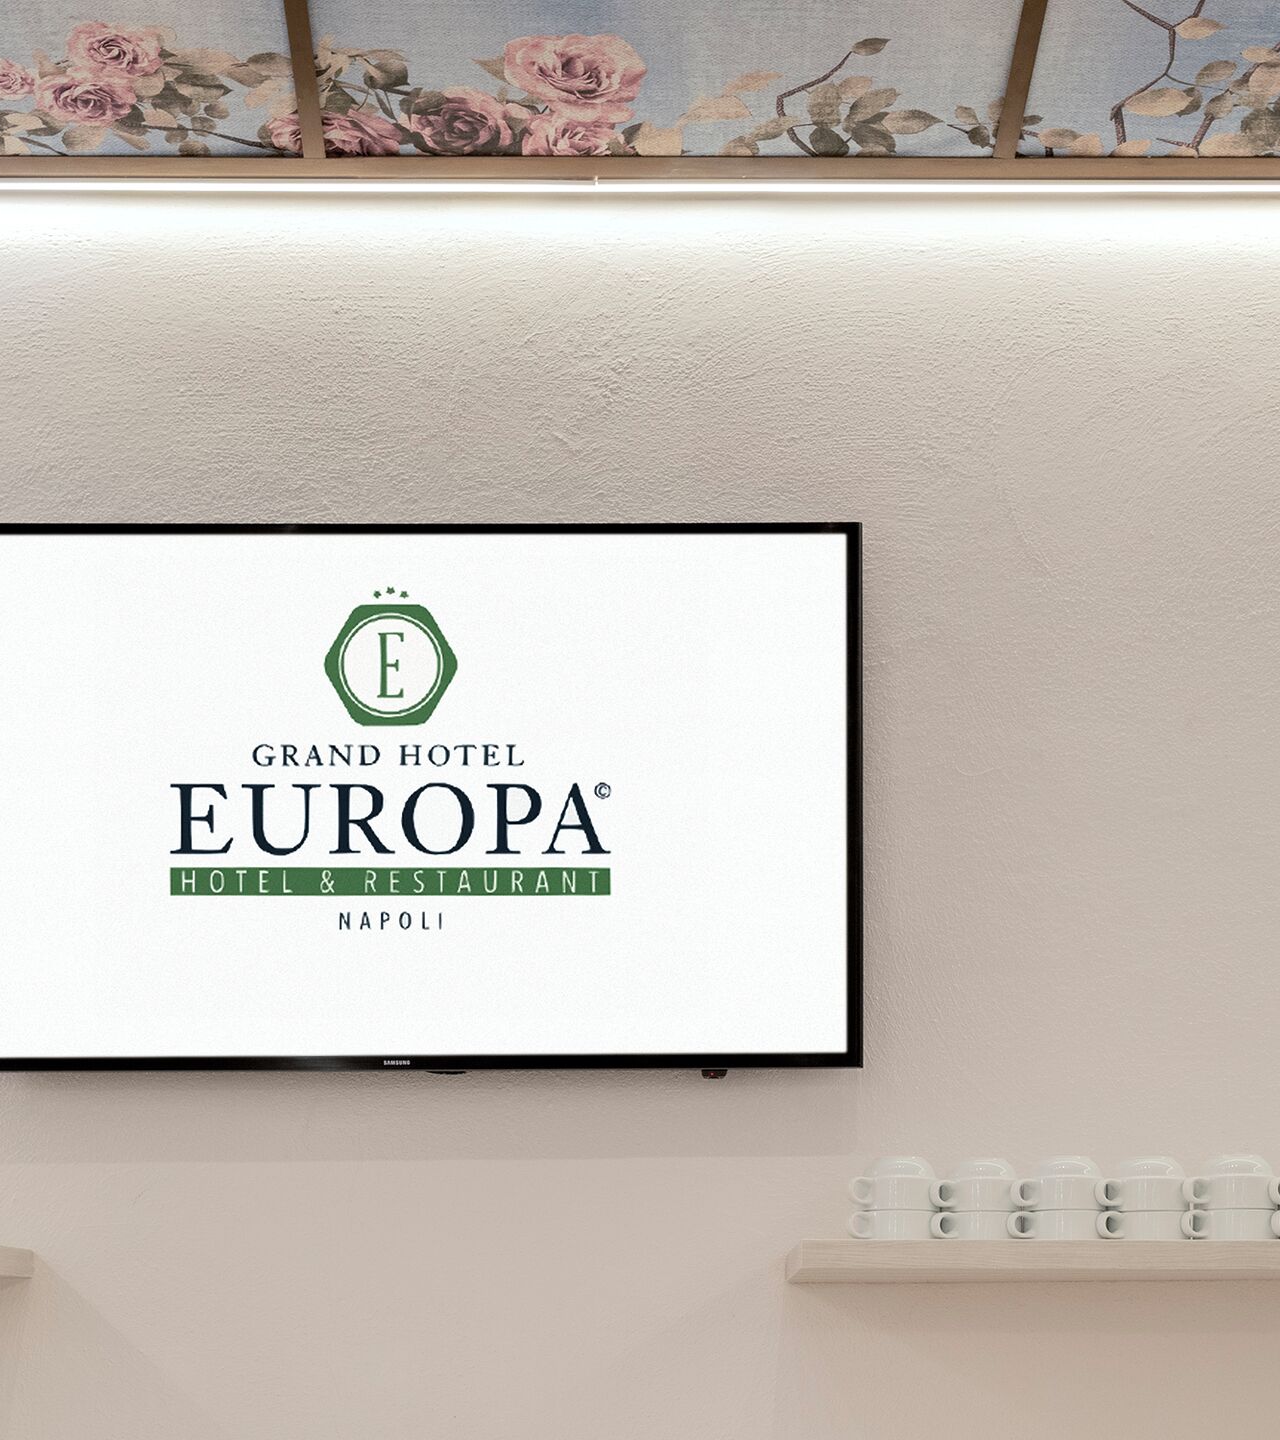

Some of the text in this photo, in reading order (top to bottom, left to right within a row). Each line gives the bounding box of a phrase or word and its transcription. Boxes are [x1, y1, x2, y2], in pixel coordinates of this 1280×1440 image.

[376, 631, 405, 699] E
[251, 743, 525, 768] GRAND HOTEL
[181, 869, 599, 894] HOTEL & RESTAURANT
[338, 911, 443, 931] NAPOLI
